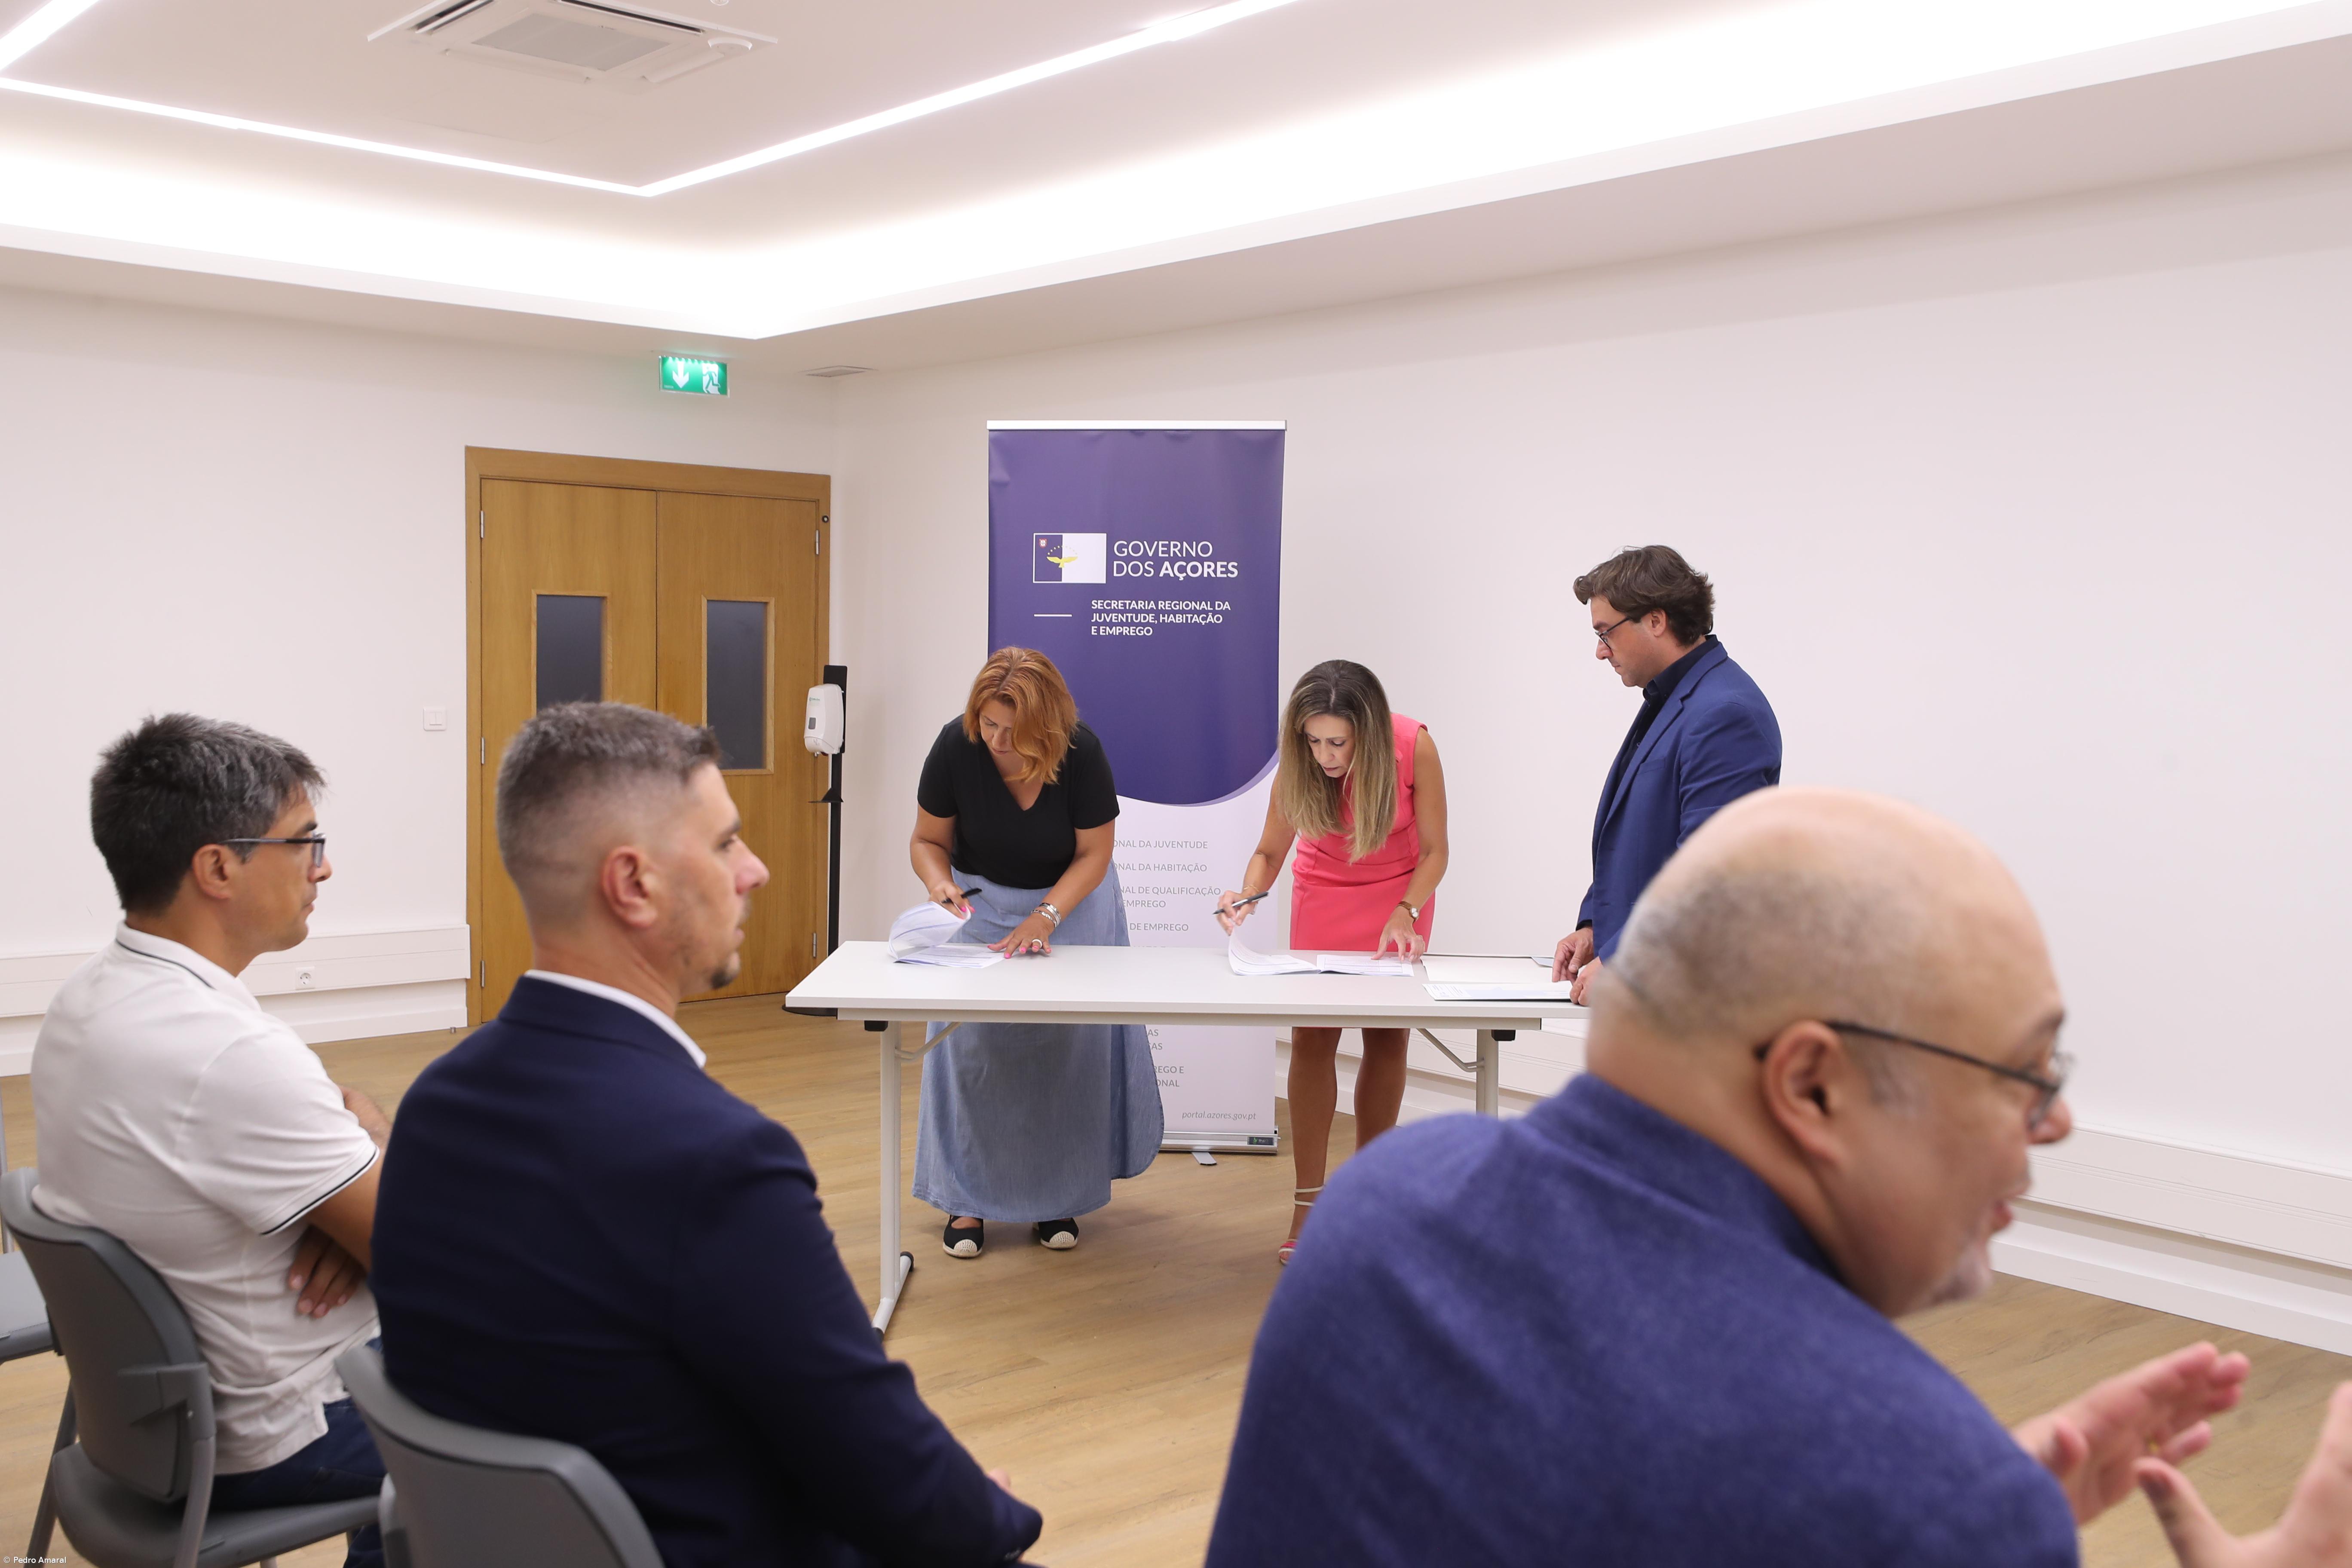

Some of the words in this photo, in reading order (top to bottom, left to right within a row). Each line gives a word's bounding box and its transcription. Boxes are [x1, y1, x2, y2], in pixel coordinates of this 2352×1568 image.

[1114, 540, 1213, 557] GOVERNO
[1113, 560, 1155, 577] DOS
[1159, 561, 1238, 581] AÇORES
[1091, 600, 1156, 610] SECRETARIA
[1158, 600, 1213, 610] REGIONAL
[1215, 601, 1231, 611] DA
[1091, 613, 1158, 624] JUVENTUDE,
[1159, 612, 1223, 625] HABITAÇÃO
[1091, 626, 1098, 635] E
[1099, 626, 1153, 636] EMPREGO
[1154, 840, 1208, 849] JUVENTUDE
[1154, 863, 1207, 873] HABITAÇÃO
[1152, 886, 1221, 896] QUALIFICAÇÃO
[1144, 923, 1189, 931] EMPREGO
[1182, 1111, 1256, 1121] portal.azores.gov.pt
